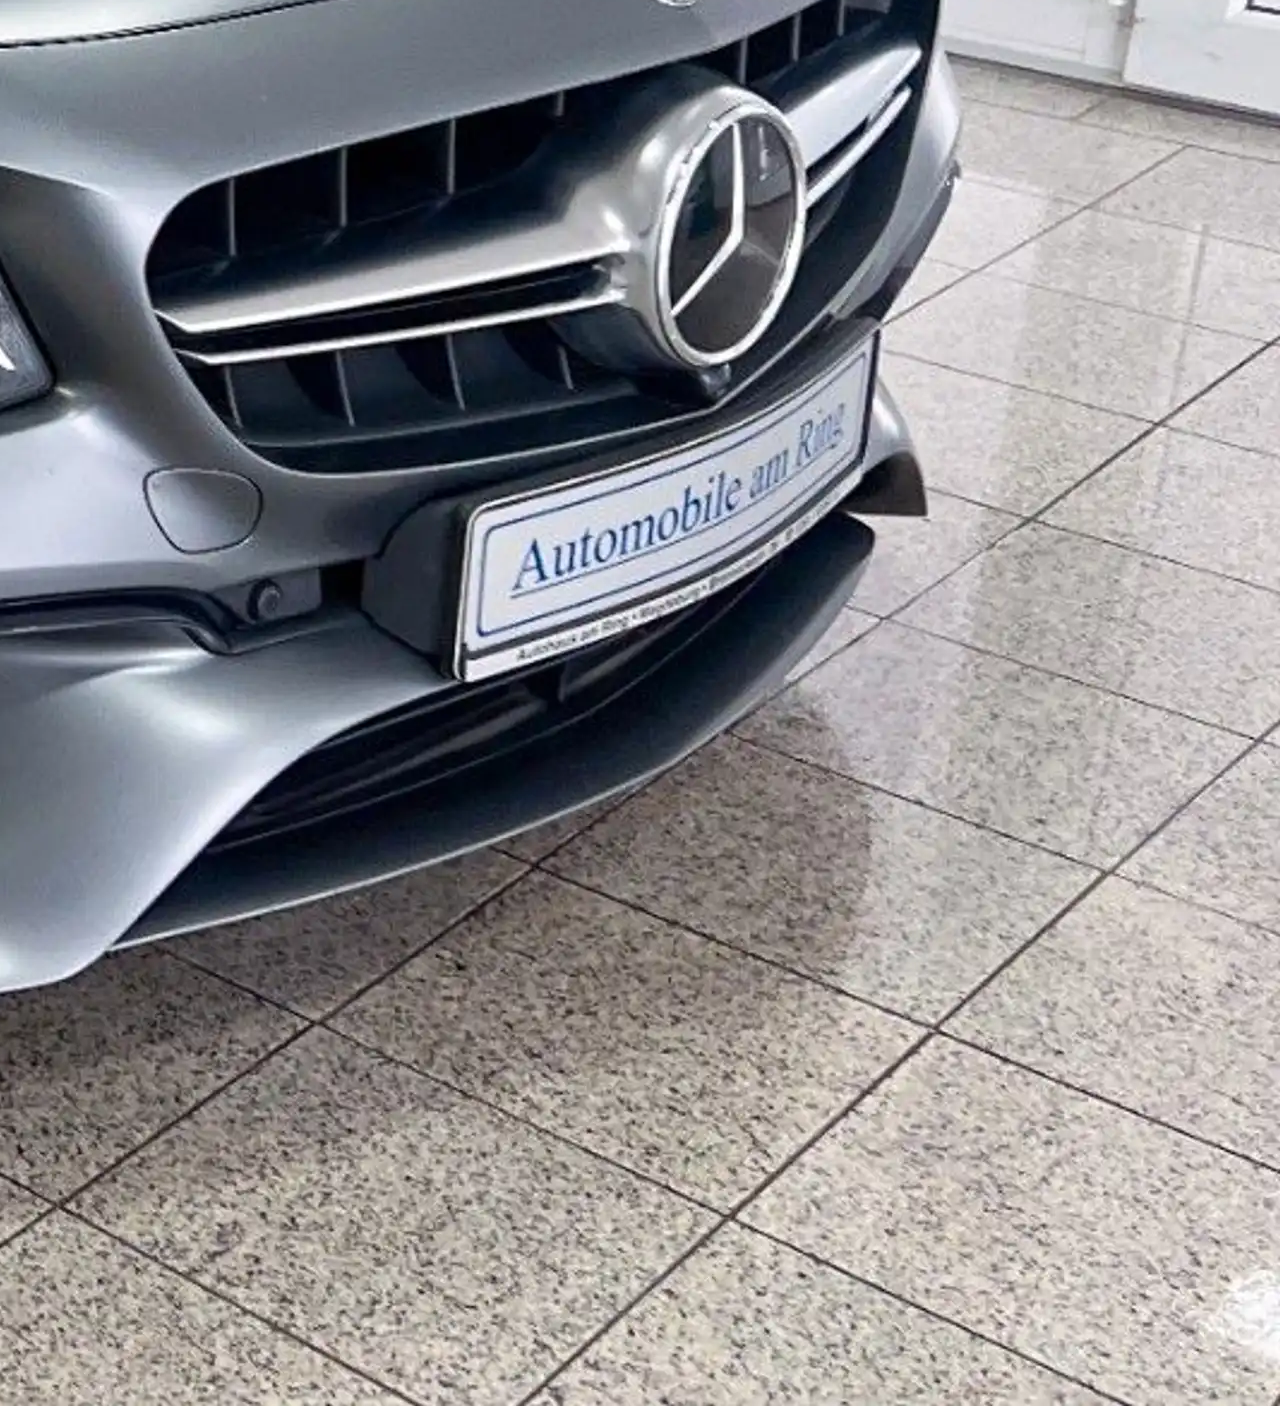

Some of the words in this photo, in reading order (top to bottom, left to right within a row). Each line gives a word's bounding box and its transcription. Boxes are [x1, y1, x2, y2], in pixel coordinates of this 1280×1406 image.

[512, 470, 743, 592] Automobile
[749, 447, 790, 499] am
[794, 403, 846, 470] Ring
